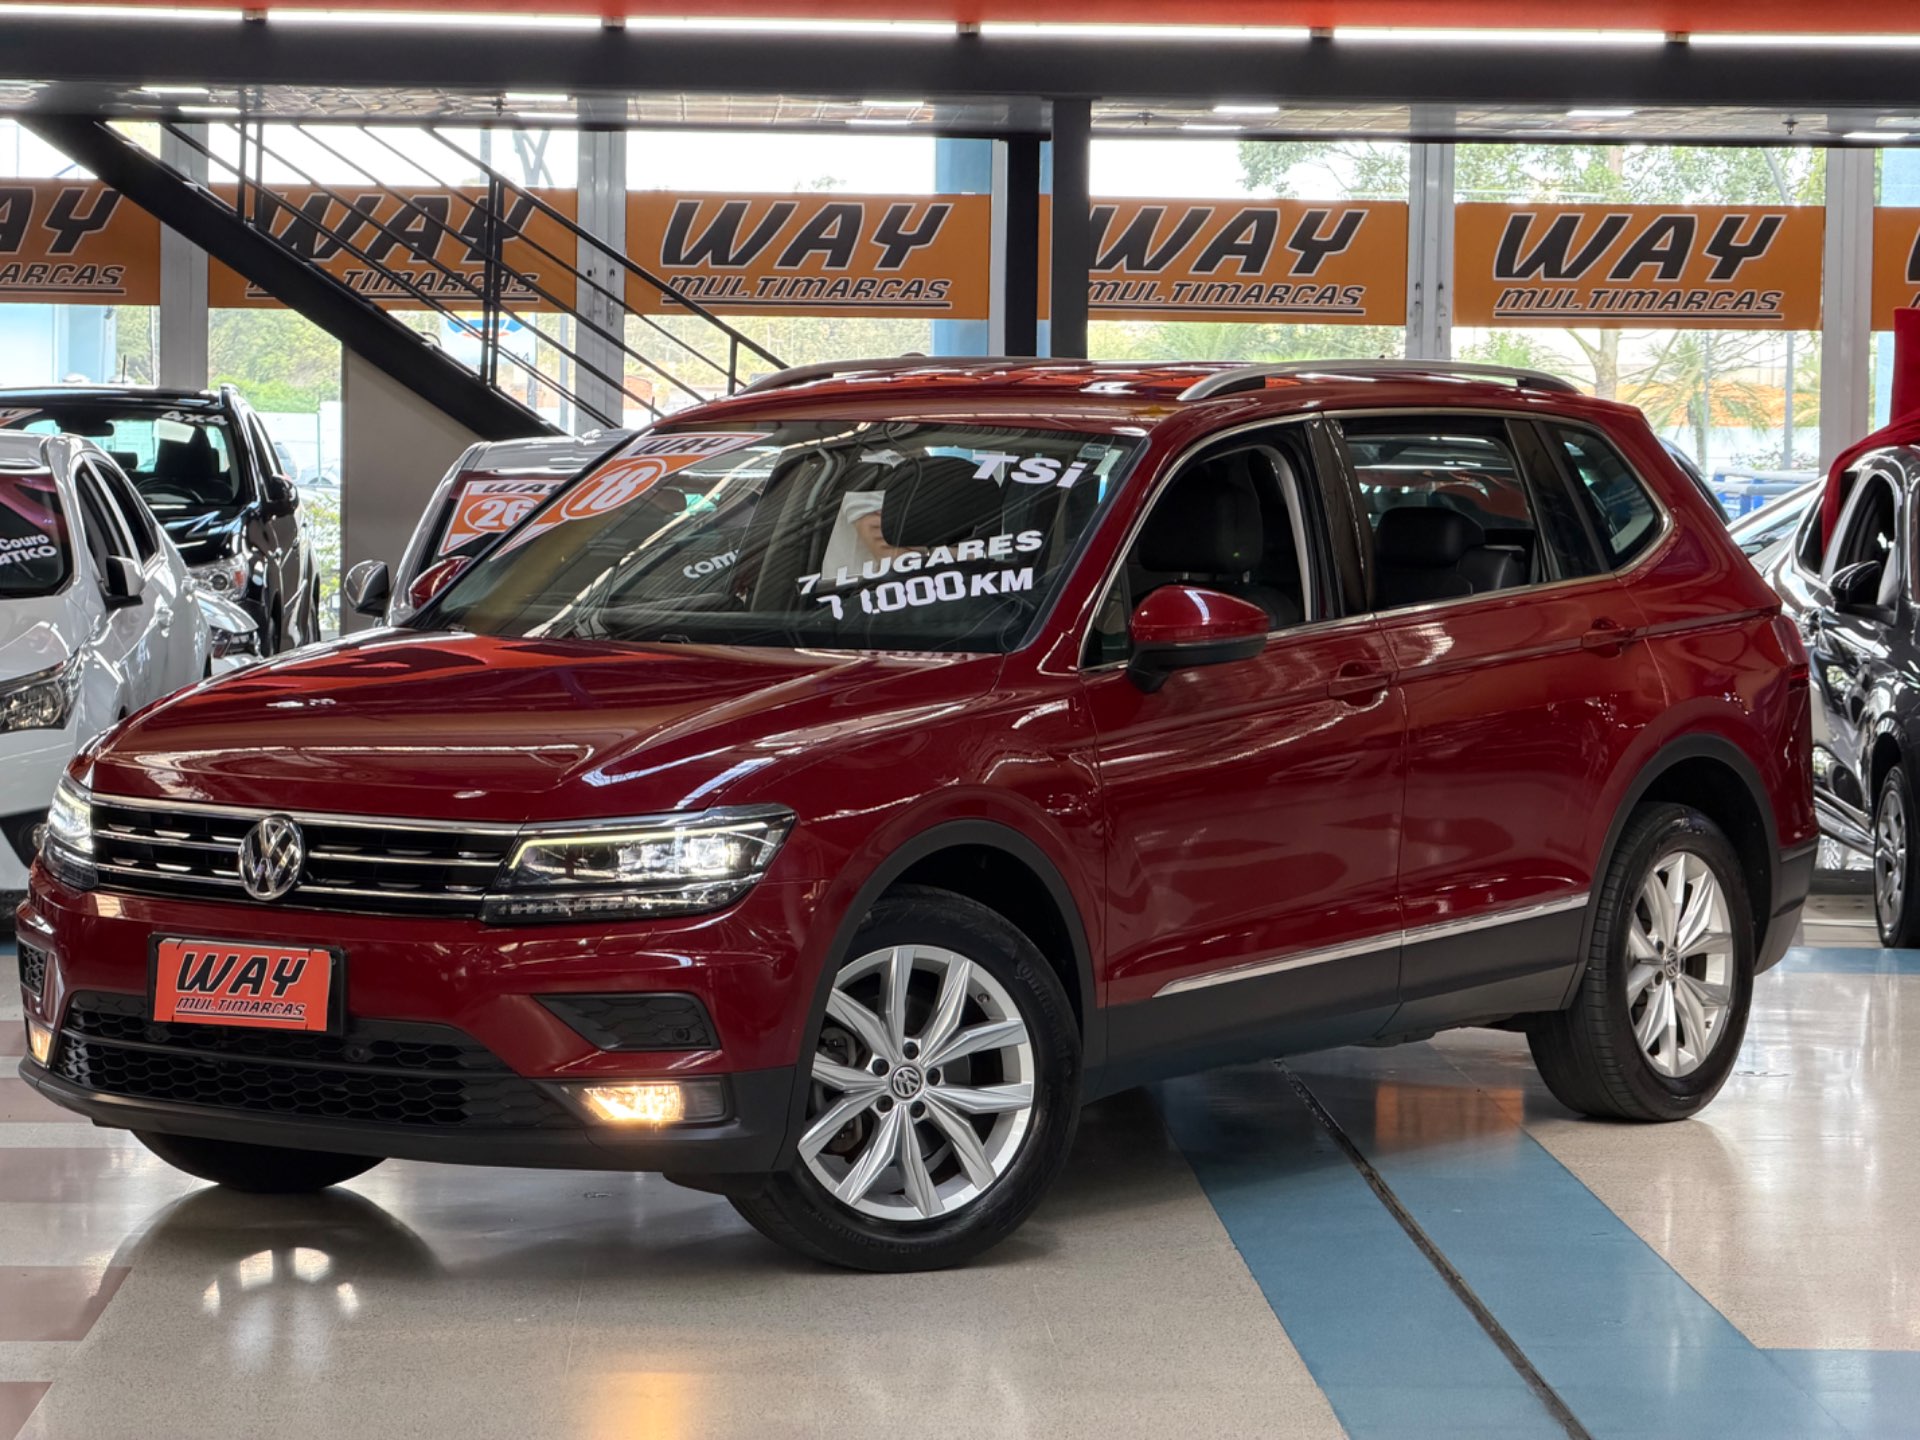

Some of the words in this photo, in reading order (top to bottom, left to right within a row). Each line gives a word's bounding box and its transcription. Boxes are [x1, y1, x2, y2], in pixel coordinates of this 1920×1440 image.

[258, 192, 537, 264] WAY
[660, 199, 953, 270] WAY
[1088, 205, 1369, 277] WAY
[1493, 212, 1787, 282] WAY
[662, 275, 952, 300] MULTIMARCAS
[1088, 279, 1366, 306] MULTIMARCAS
[1494, 287, 1784, 312] MULTIMARCAS
[632, 437, 731, 455] WAY
[571, 465, 658, 511] 18
[474, 500, 536, 526] 26
[0, 534, 49, 550] Couro
[682, 549, 739, 578] com
[798, 573, 821, 595] 7
[835, 530, 1043, 586] LUGARES
[176, 952, 308, 998] WAY
[175, 995, 306, 1016] MULTIMARCAS
